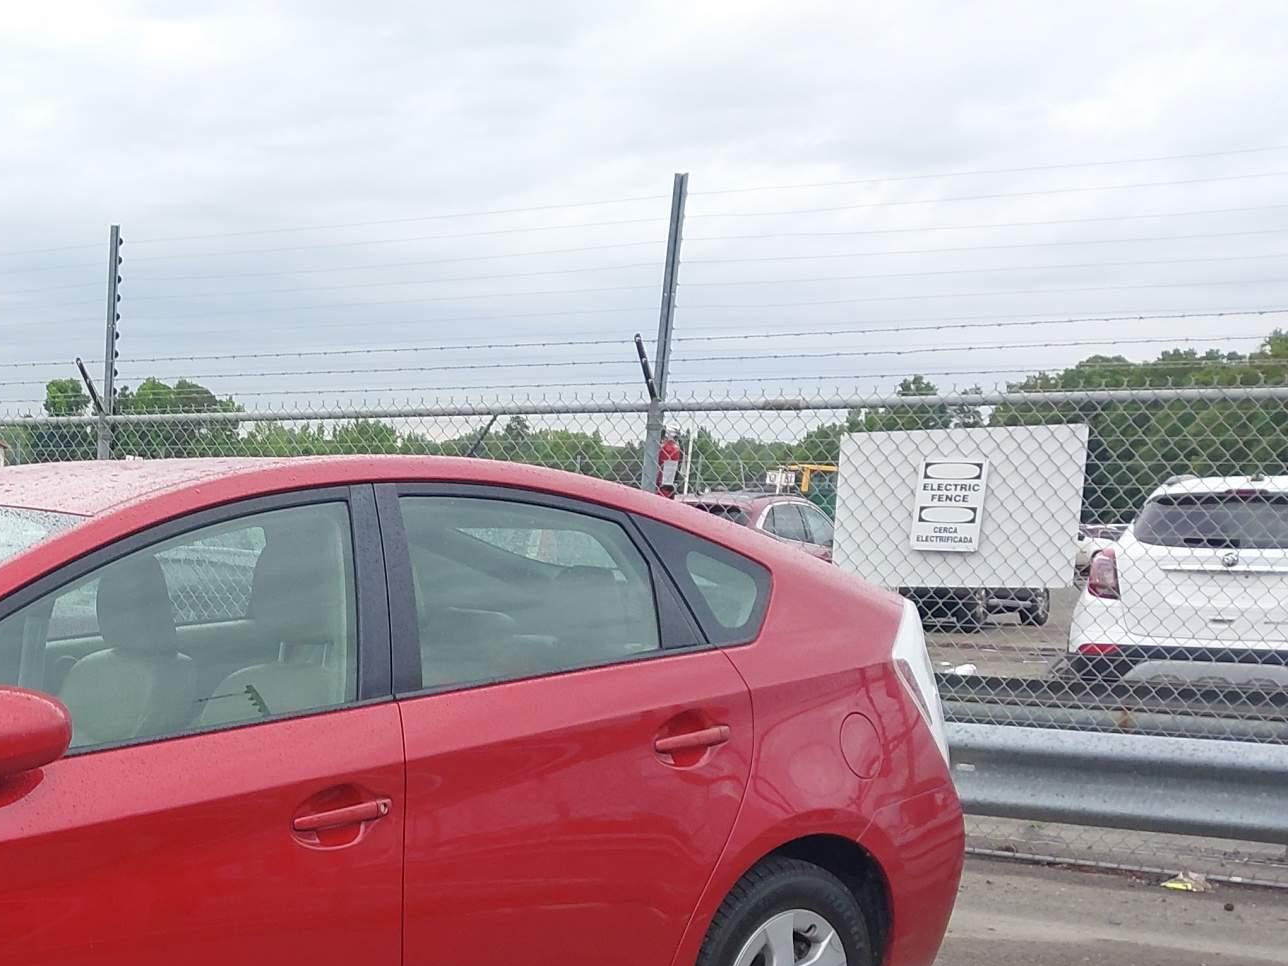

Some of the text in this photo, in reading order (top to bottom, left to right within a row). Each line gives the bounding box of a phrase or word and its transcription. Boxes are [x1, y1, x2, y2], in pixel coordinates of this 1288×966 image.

[922, 483, 980, 492] ELECTRIC
[930, 494, 969, 503] FENCE
[933, 526, 958, 534] CERCA
[916, 534, 973, 544] ELECTRIFICADA
